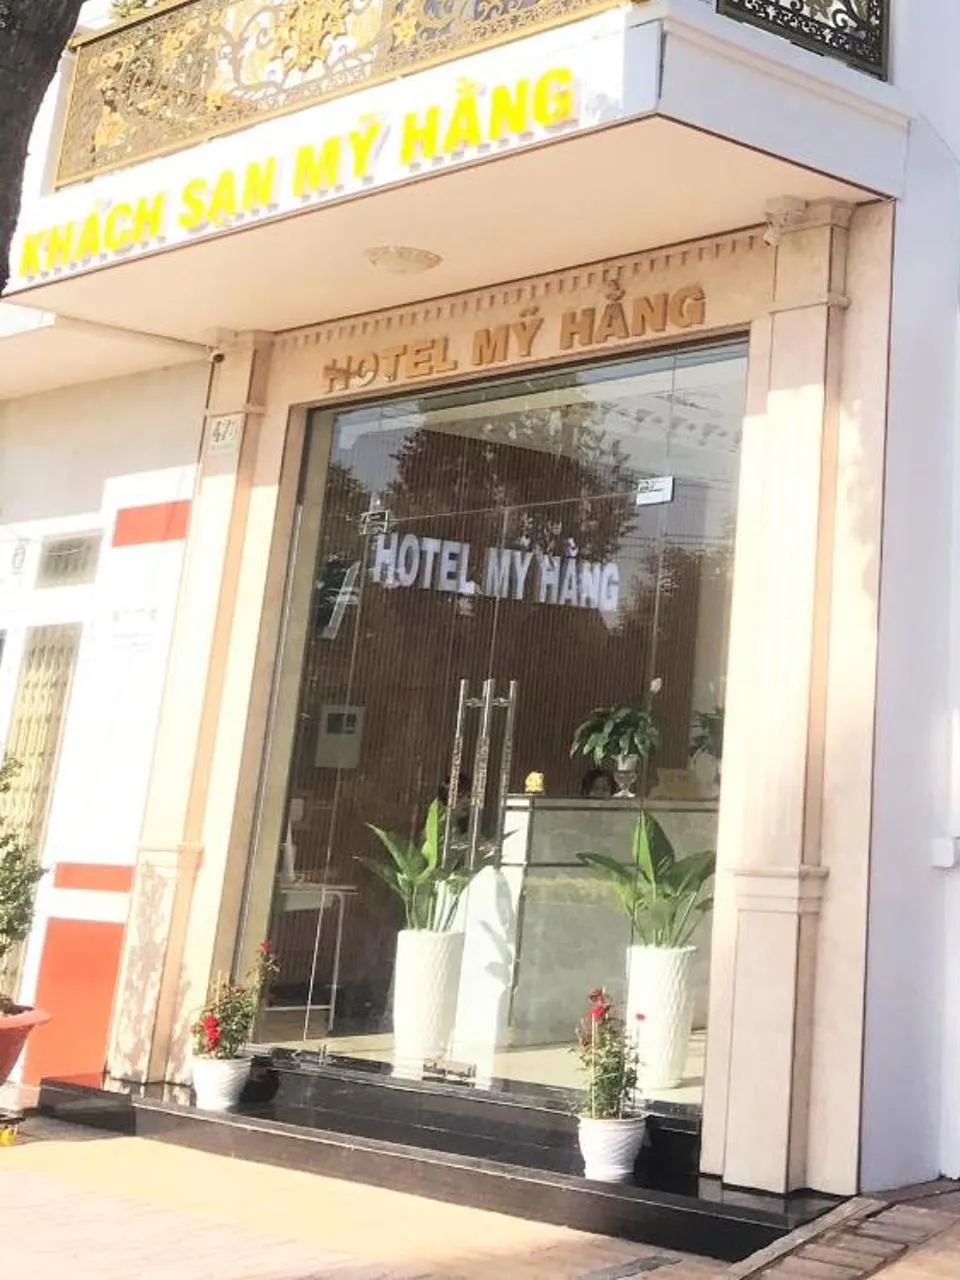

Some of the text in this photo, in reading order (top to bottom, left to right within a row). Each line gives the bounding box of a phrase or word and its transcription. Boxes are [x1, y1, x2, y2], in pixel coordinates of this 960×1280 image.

[18, 191, 165, 277] KHÁCH
[292, 111, 381, 198] MỸ
[400, 66, 574, 165] HẰNG
[323, 277, 707, 394] HOTEL MỸ HẰNG
[372, 532, 478, 596] HOTEL
